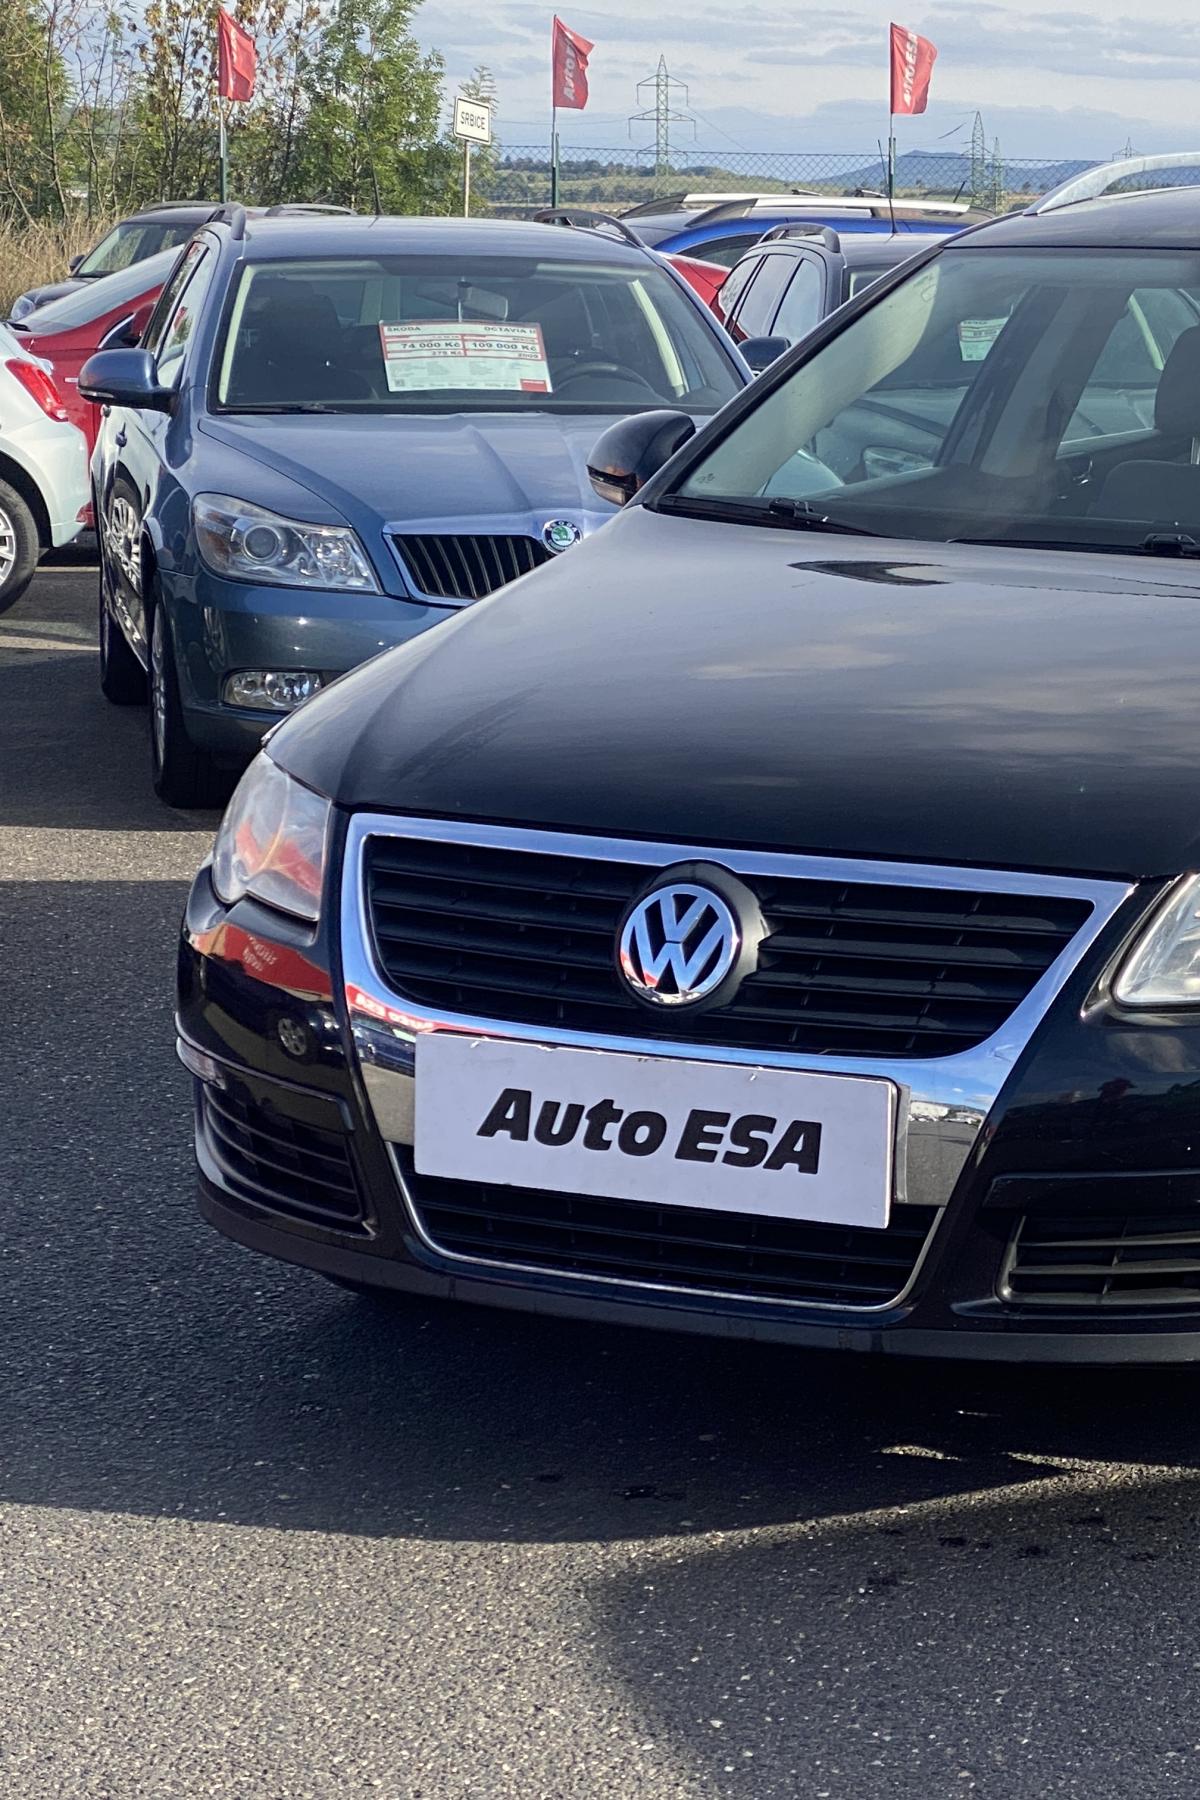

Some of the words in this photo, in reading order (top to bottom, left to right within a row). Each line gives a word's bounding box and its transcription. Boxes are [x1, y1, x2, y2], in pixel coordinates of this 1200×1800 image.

[460, 111, 486, 130] SRBICE
[477, 1087, 668, 1157] Auto
[674, 1109, 823, 1175] ESA
